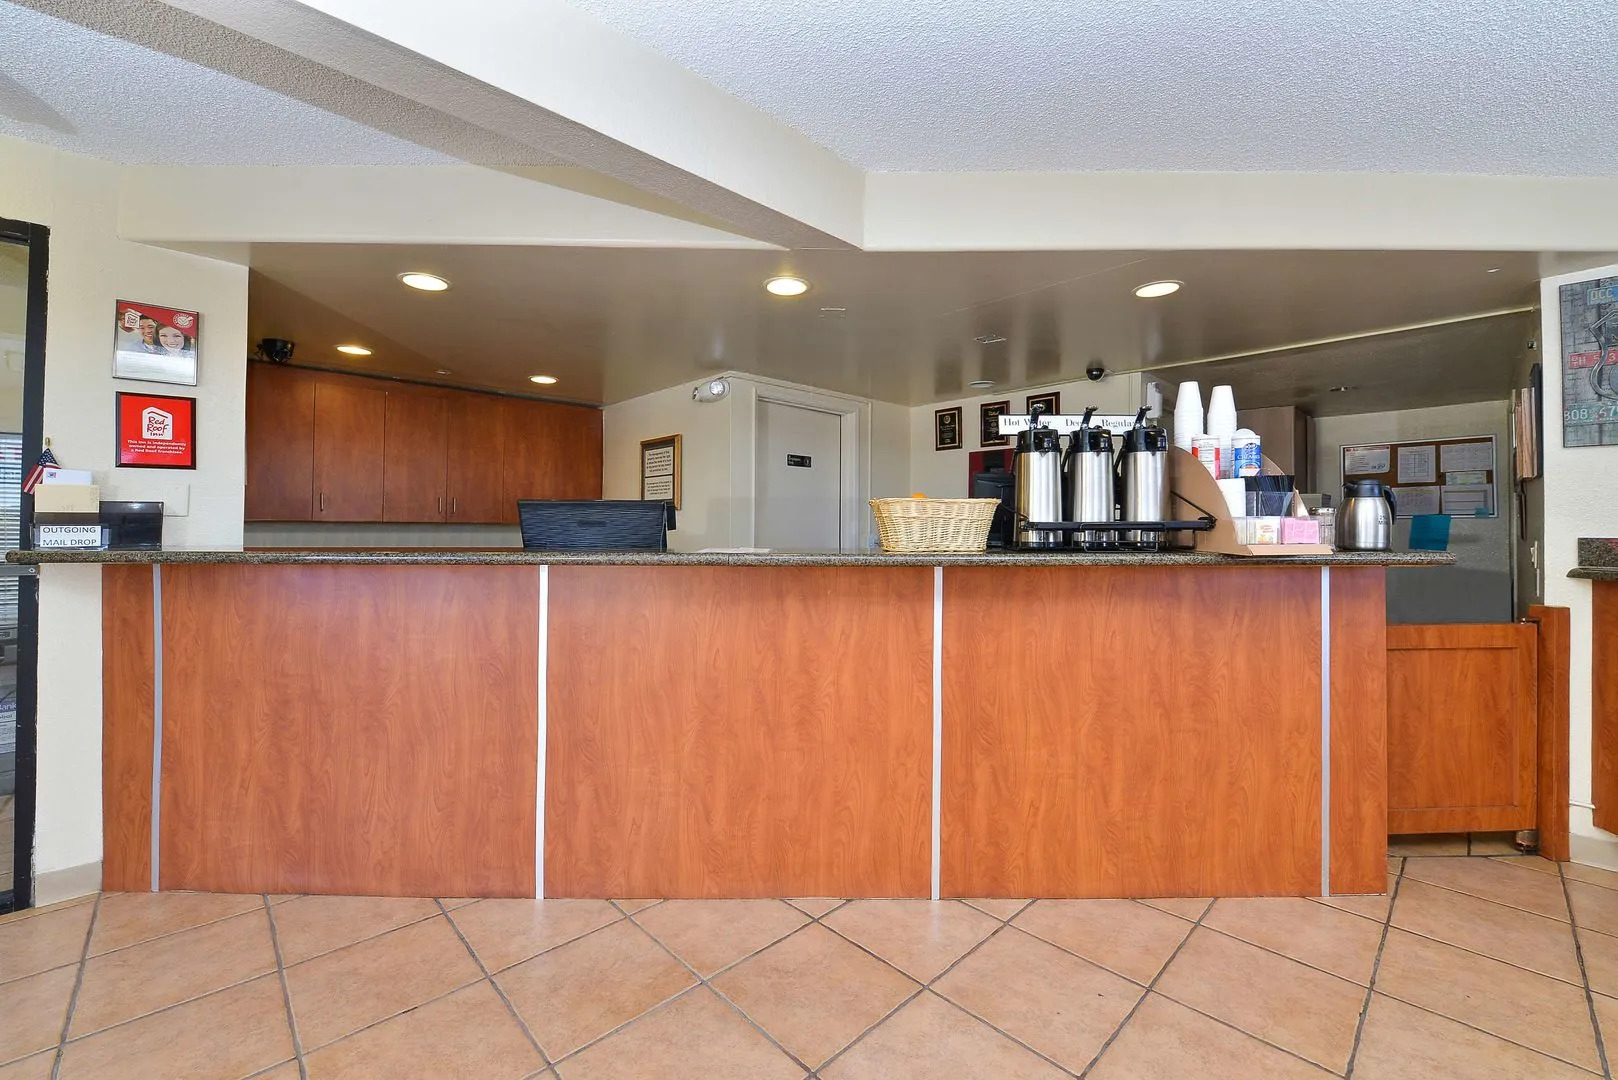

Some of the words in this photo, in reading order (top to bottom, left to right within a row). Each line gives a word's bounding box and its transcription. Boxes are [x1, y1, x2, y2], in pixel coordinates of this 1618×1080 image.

[148, 416, 166, 424] Red
[1003, 417, 1020, 427] Hot
[147, 424, 169, 433] Roof
